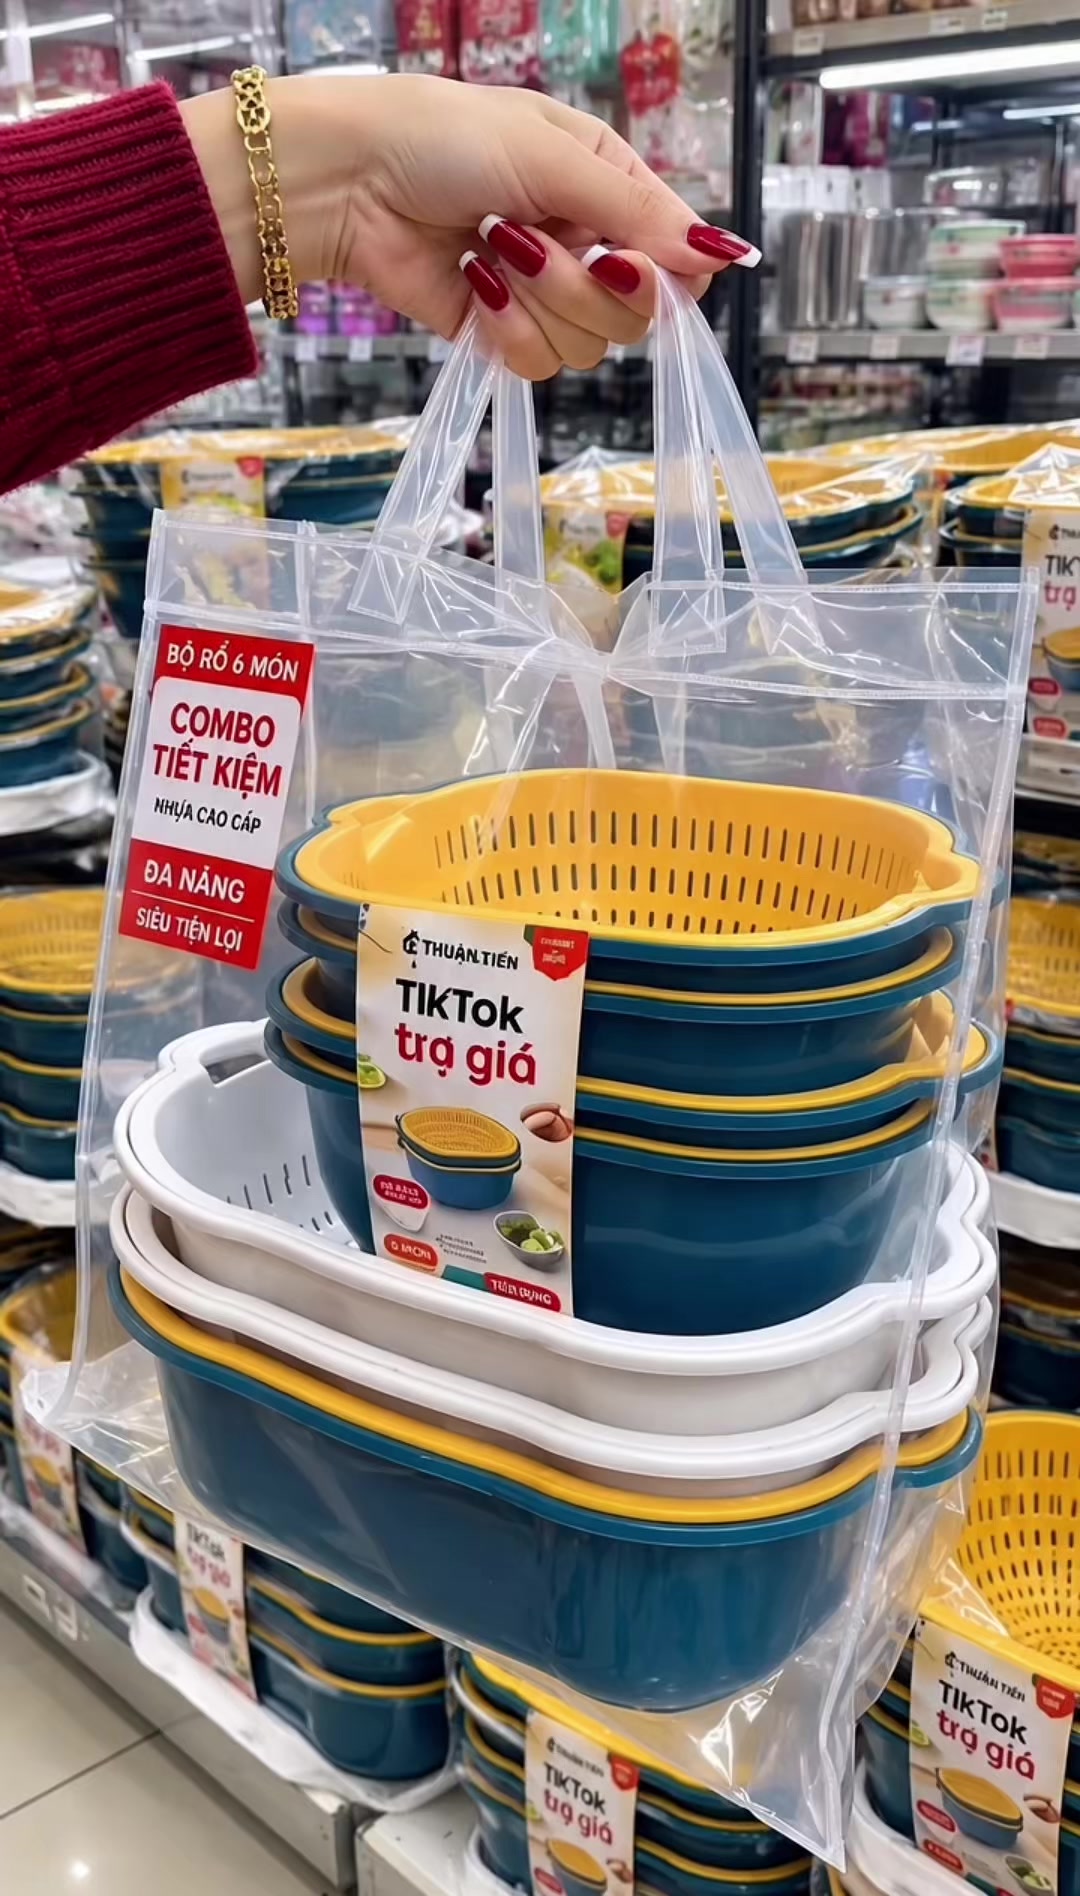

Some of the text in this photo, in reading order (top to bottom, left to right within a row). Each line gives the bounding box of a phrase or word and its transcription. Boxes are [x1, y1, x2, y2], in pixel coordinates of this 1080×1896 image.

[167, 640, 194, 672] BỘ
[232, 653, 244, 675] 6
[250, 652, 299, 682] MÓN
[170, 702, 275, 748] COMBO
[153, 738, 282, 800] TIẾT KIỆM
[196, 806, 228, 828] CAO
[143, 859, 173, 888] ĐA
[136, 906, 172, 933] SIÊU
[466, 1040, 536, 1086] giá
[985, 1741, 1035, 1781] giá
